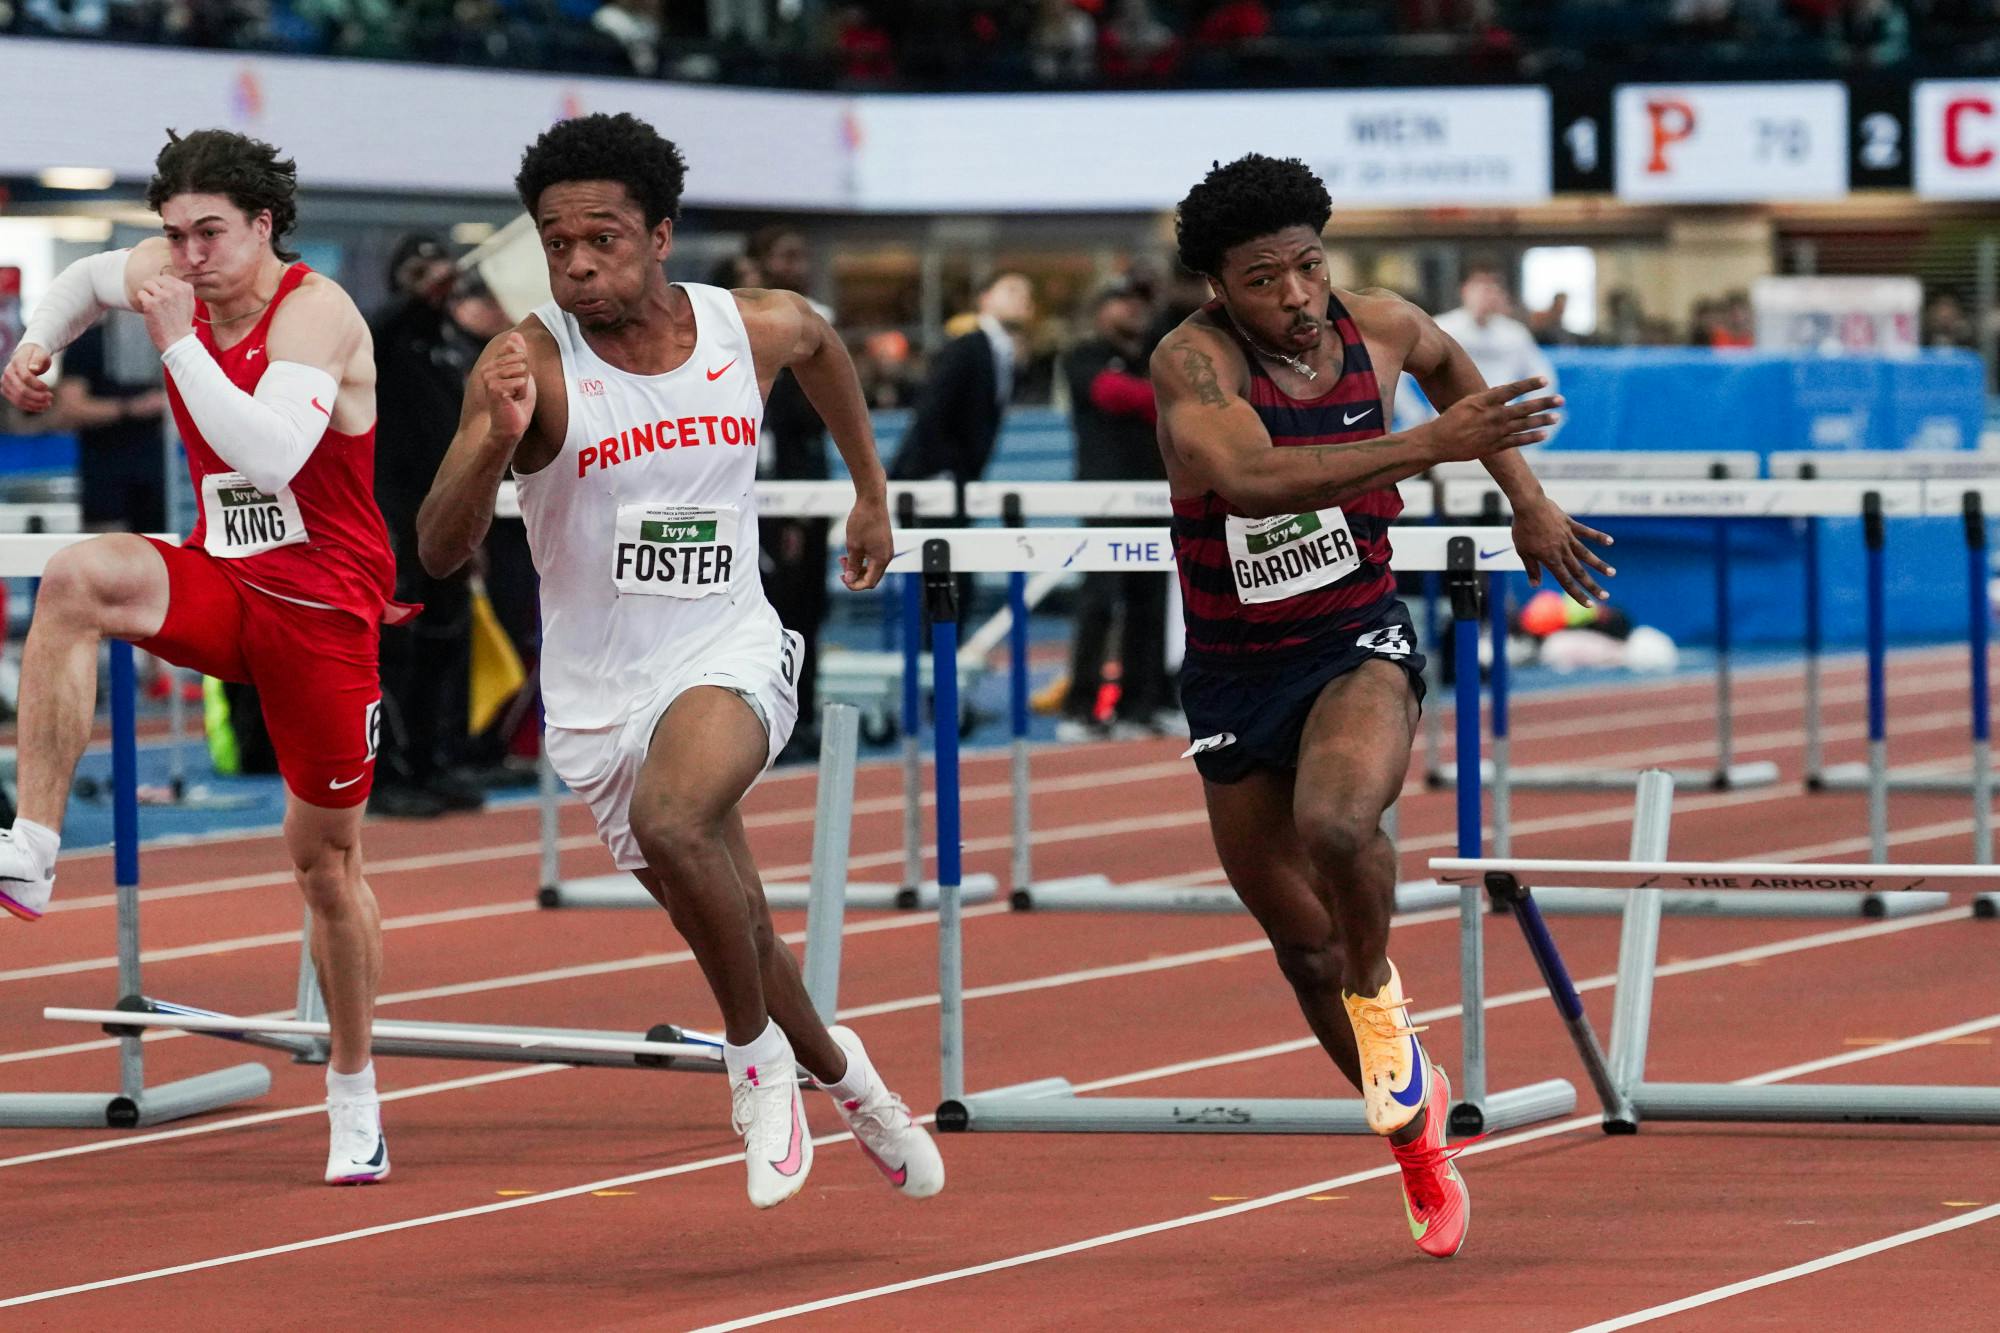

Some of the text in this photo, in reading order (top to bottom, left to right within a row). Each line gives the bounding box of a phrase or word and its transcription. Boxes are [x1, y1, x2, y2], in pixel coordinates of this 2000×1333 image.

[1564, 117, 1598, 172] 1
[1646, 99, 1695, 175] P
[1860, 112, 1901, 169] 2
[1943, 98, 1994, 169] C
[578, 415, 756, 479] PRINCETON
[231, 489, 252, 503] Ivy
[224, 505, 286, 546] KING
[661, 524, 686, 540] Ivy
[1264, 528, 1289, 546] Ivy
[616, 543, 733, 585] FOSTER
[1107, 542, 1160, 562] THE
[1235, 528, 1354, 589] GARDNER
[1682, 876, 1876, 890] THE ARMORY
